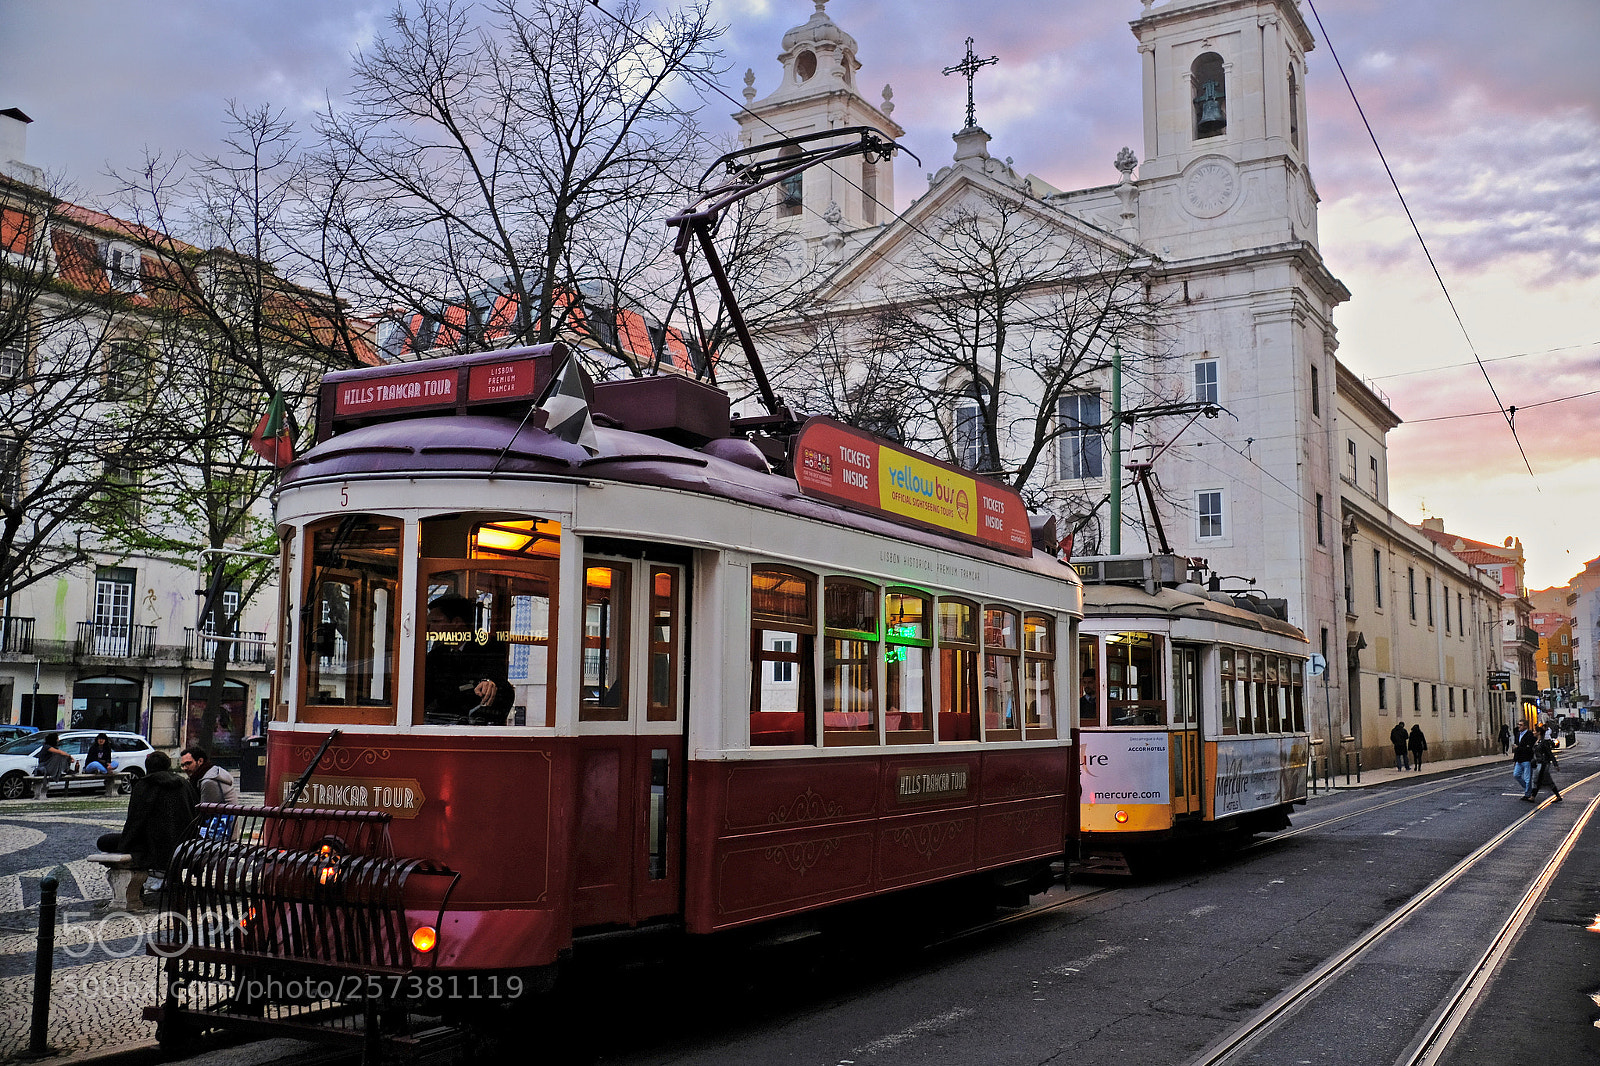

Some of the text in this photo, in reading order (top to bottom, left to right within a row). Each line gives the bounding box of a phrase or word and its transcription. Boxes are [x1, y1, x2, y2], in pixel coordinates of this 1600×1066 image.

[488, 375, 516, 384] PREMIUM
[491, 366, 514, 376] LISBON
[344, 379, 451, 405] HILLS TRAMCAR TOUR
[488, 384, 515, 393] TRAMCAR
[839, 446, 871, 470] TICKETS
[843, 469, 868, 490] INSIDE
[935, 476, 954, 504] bus
[340, 486, 349, 507] 5
[892, 491, 954, 518] OFFICIAL SIGHTSEEING TOURS
[983, 495, 1005, 514] TICKETS
[985, 514, 1003, 531] INSIDE
[880, 550, 900, 564] LISBON
[903, 556, 933, 572] HISTORICAL
[936, 563, 958, 577] PREMIUM
[900, 771, 967, 795] HILLS TRAMCAR TOUR
[1216, 776, 1249, 797] Mercure
[312, 783, 369, 807] TRAMCAR
[373, 786, 414, 809] TOUR
[1094, 791, 1161, 799] mercure.com
